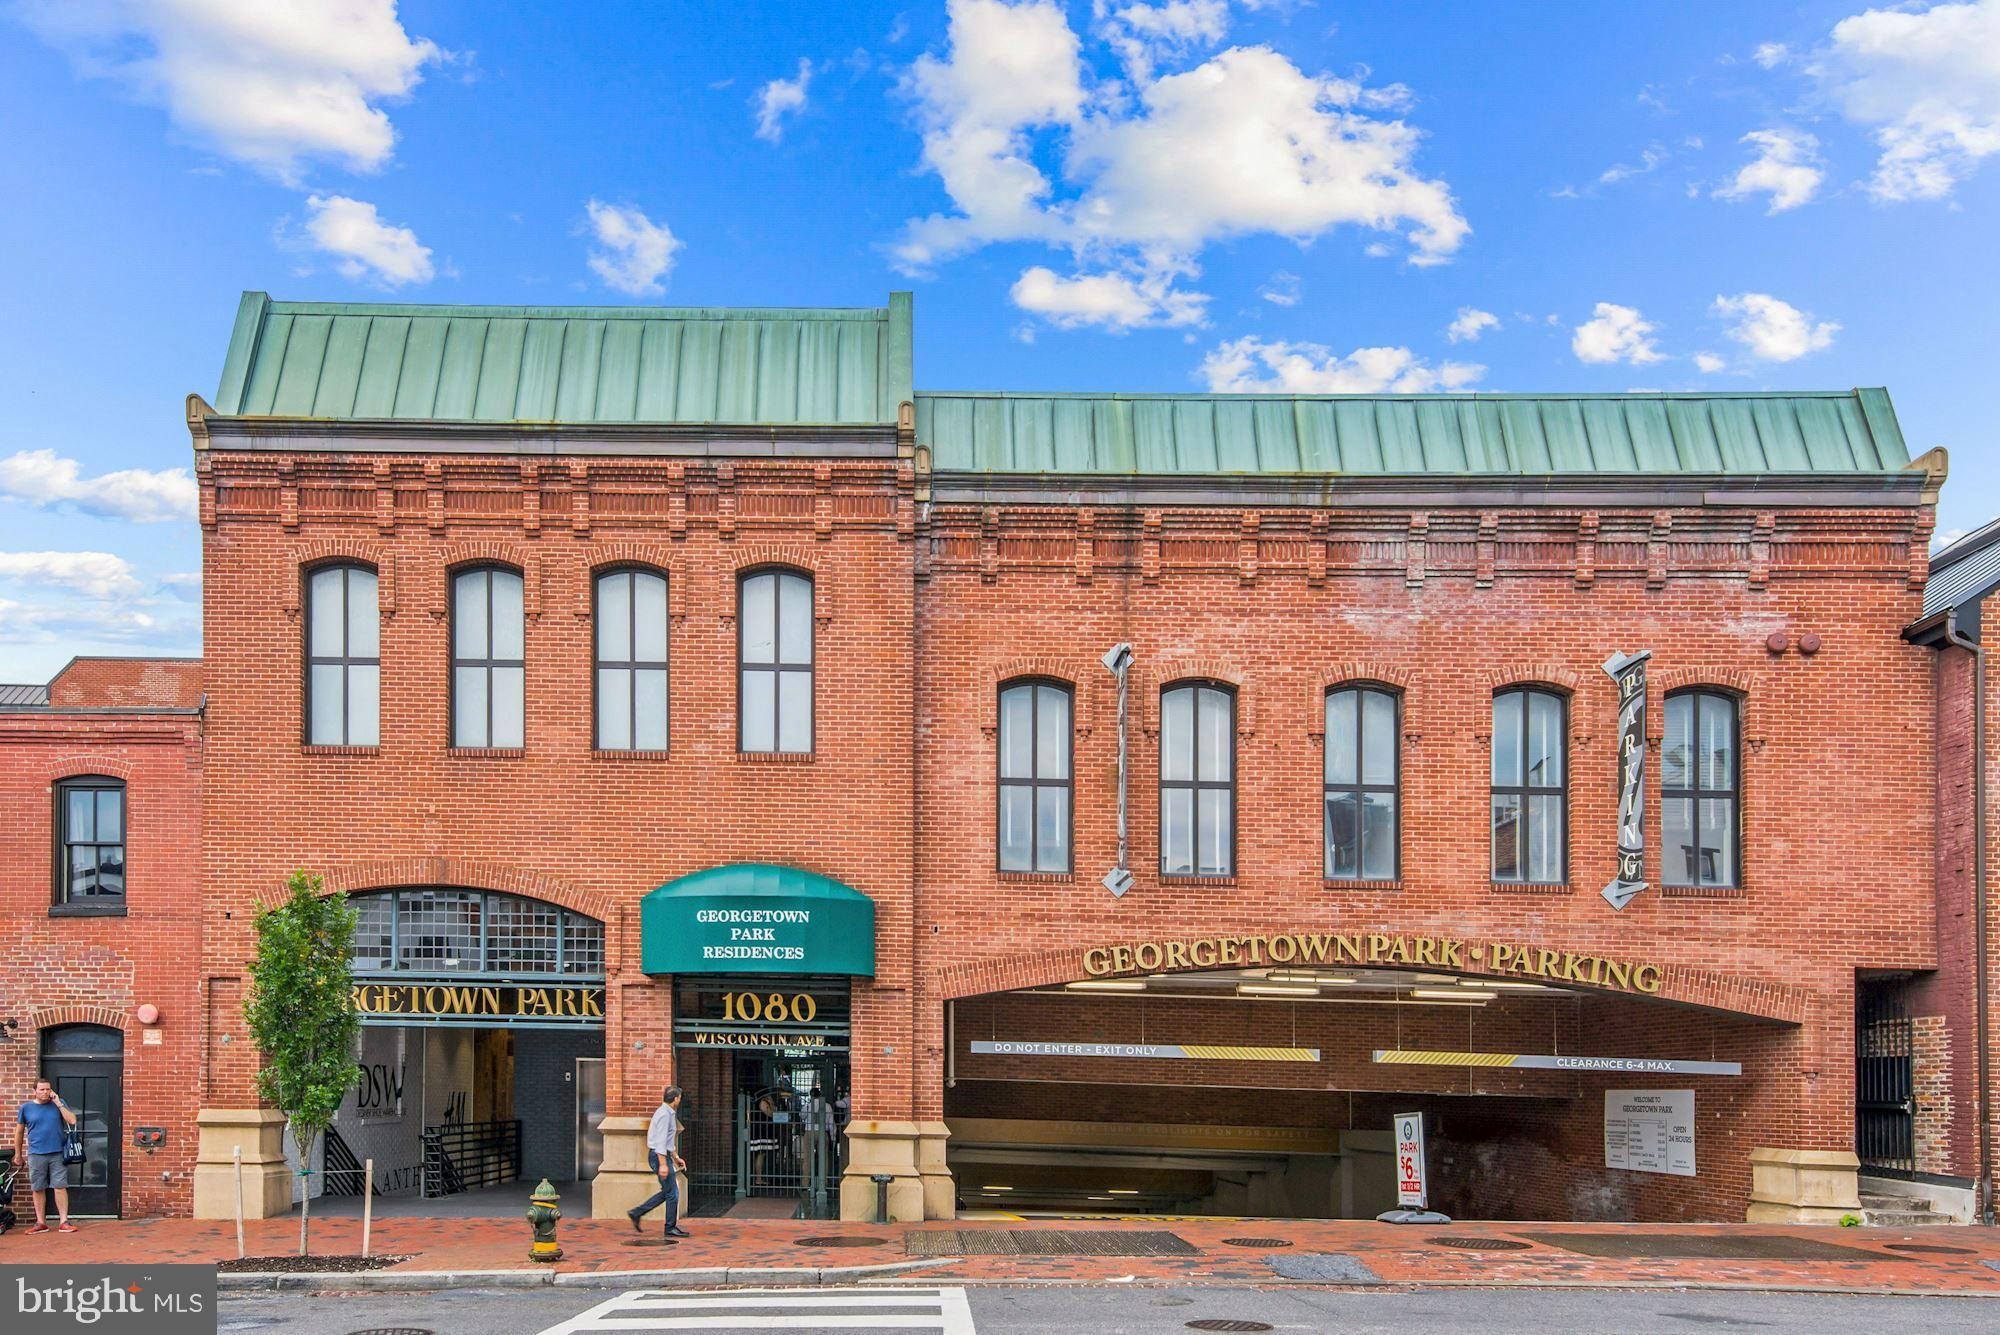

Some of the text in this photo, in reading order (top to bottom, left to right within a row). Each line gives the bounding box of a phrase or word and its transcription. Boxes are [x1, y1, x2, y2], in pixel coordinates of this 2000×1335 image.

[1623, 674, 1637, 876] PARKING
[697, 910, 810, 923] GEORGETOWN
[731, 928, 775, 940] PARK
[703, 946, 804, 959] RESIDENCES
[1083, 934, 1663, 994] GEORGETOWN PARK PARKING
[516, 987, 605, 1016] PARK
[722, 992, 816, 1022] 1080
[695, 1033, 786, 1045] WISCONSIN
[995, 1043, 1011, 1052] DO
[1016, 1044, 1040, 1053] NOT
[1044, 1045, 1082, 1054] ENTER
[1095, 1046, 1121, 1055] EXIT
[1126, 1046, 1157, 1056] ONLY
[1556, 1058, 1675, 1071] CLEARANCE 6-4 MAX.
[357, 1063, 406, 1108] DSW
[1622, 1105, 1658, 1113] GEORGETOWN
[1400, 1142, 1418, 1153] PARK
